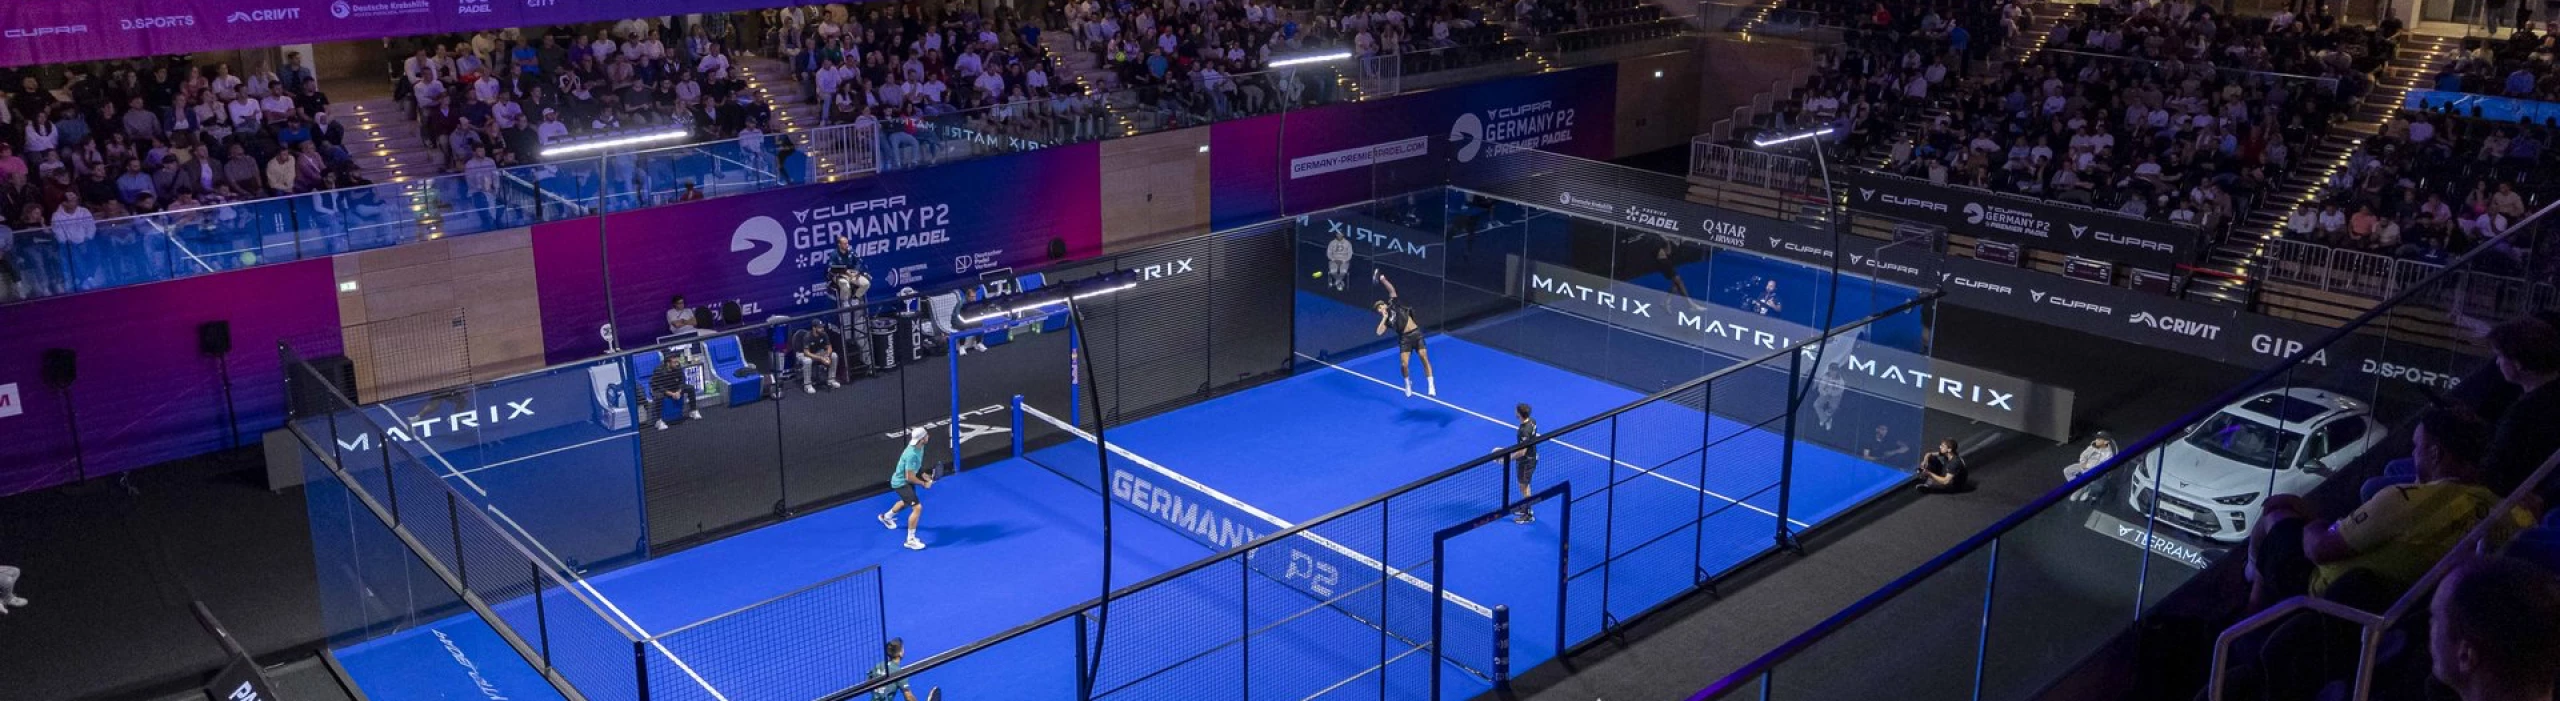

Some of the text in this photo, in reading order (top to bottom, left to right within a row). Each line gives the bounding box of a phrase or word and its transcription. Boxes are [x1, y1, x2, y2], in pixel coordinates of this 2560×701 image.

[252, 8, 300, 21] CRIVIT
[458, 4, 492, 14] PADEL
[4, 24, 87, 38] CUPRA
[120, 15, 195, 30] D.SPORTS
[1498, 100, 1552, 118] CUPRA
[1486, 108, 1575, 142] GERMANY P2
[1541, 130, 1572, 146] PADEL
[813, 195, 906, 220] CUPRA
[1881, 194, 1948, 213] CUPRA
[1995, 207, 2033, 218] CUPRA
[794, 204, 949, 249] GERMANY P2
[1639, 213, 1679, 231] PADEL
[1703, 219, 1746, 239] QATAR
[1985, 211, 2050, 231] GERMANY P2
[896, 229, 950, 250] PADEL
[2094, 231, 2174, 254] CUPRA
[1785, 242, 1833, 258] CUPRA
[1866, 259, 1919, 276] CUPRA
[1954, 277, 2012, 295] CUPRA
[1532, 274, 1652, 318] MATRIX
[2050, 296, 2112, 315] CUPRA
[2159, 316, 2220, 340] CRIVIT
[1848, 354, 2013, 411] MATRIX
[333, 397, 535, 457] MATRIX
[1112, 468, 1339, 597] GERMANY P2
